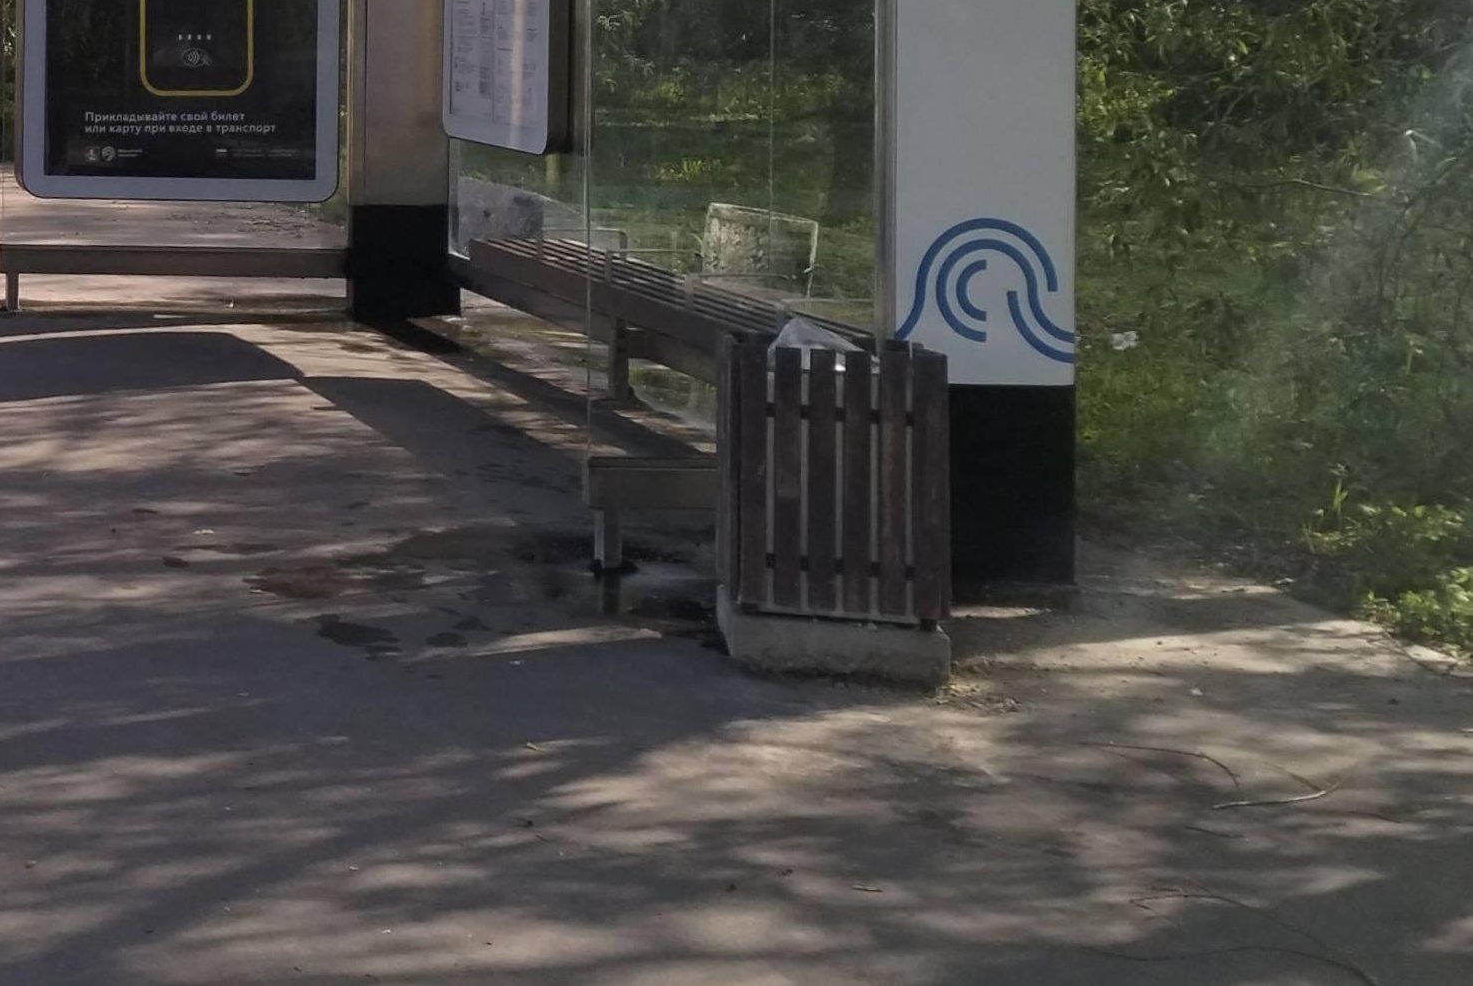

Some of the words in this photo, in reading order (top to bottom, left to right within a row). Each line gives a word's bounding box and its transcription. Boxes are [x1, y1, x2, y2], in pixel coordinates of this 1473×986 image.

[84, 110, 178, 124] Прикладывайте
[180, 111, 208, 122] свой
[210, 110, 245, 122] билет
[84, 124, 106, 134] или
[108, 124, 143, 136] карту
[144, 124, 166, 135] при
[168, 124, 204, 134] входе
[215, 124, 276, 135] транспорт
